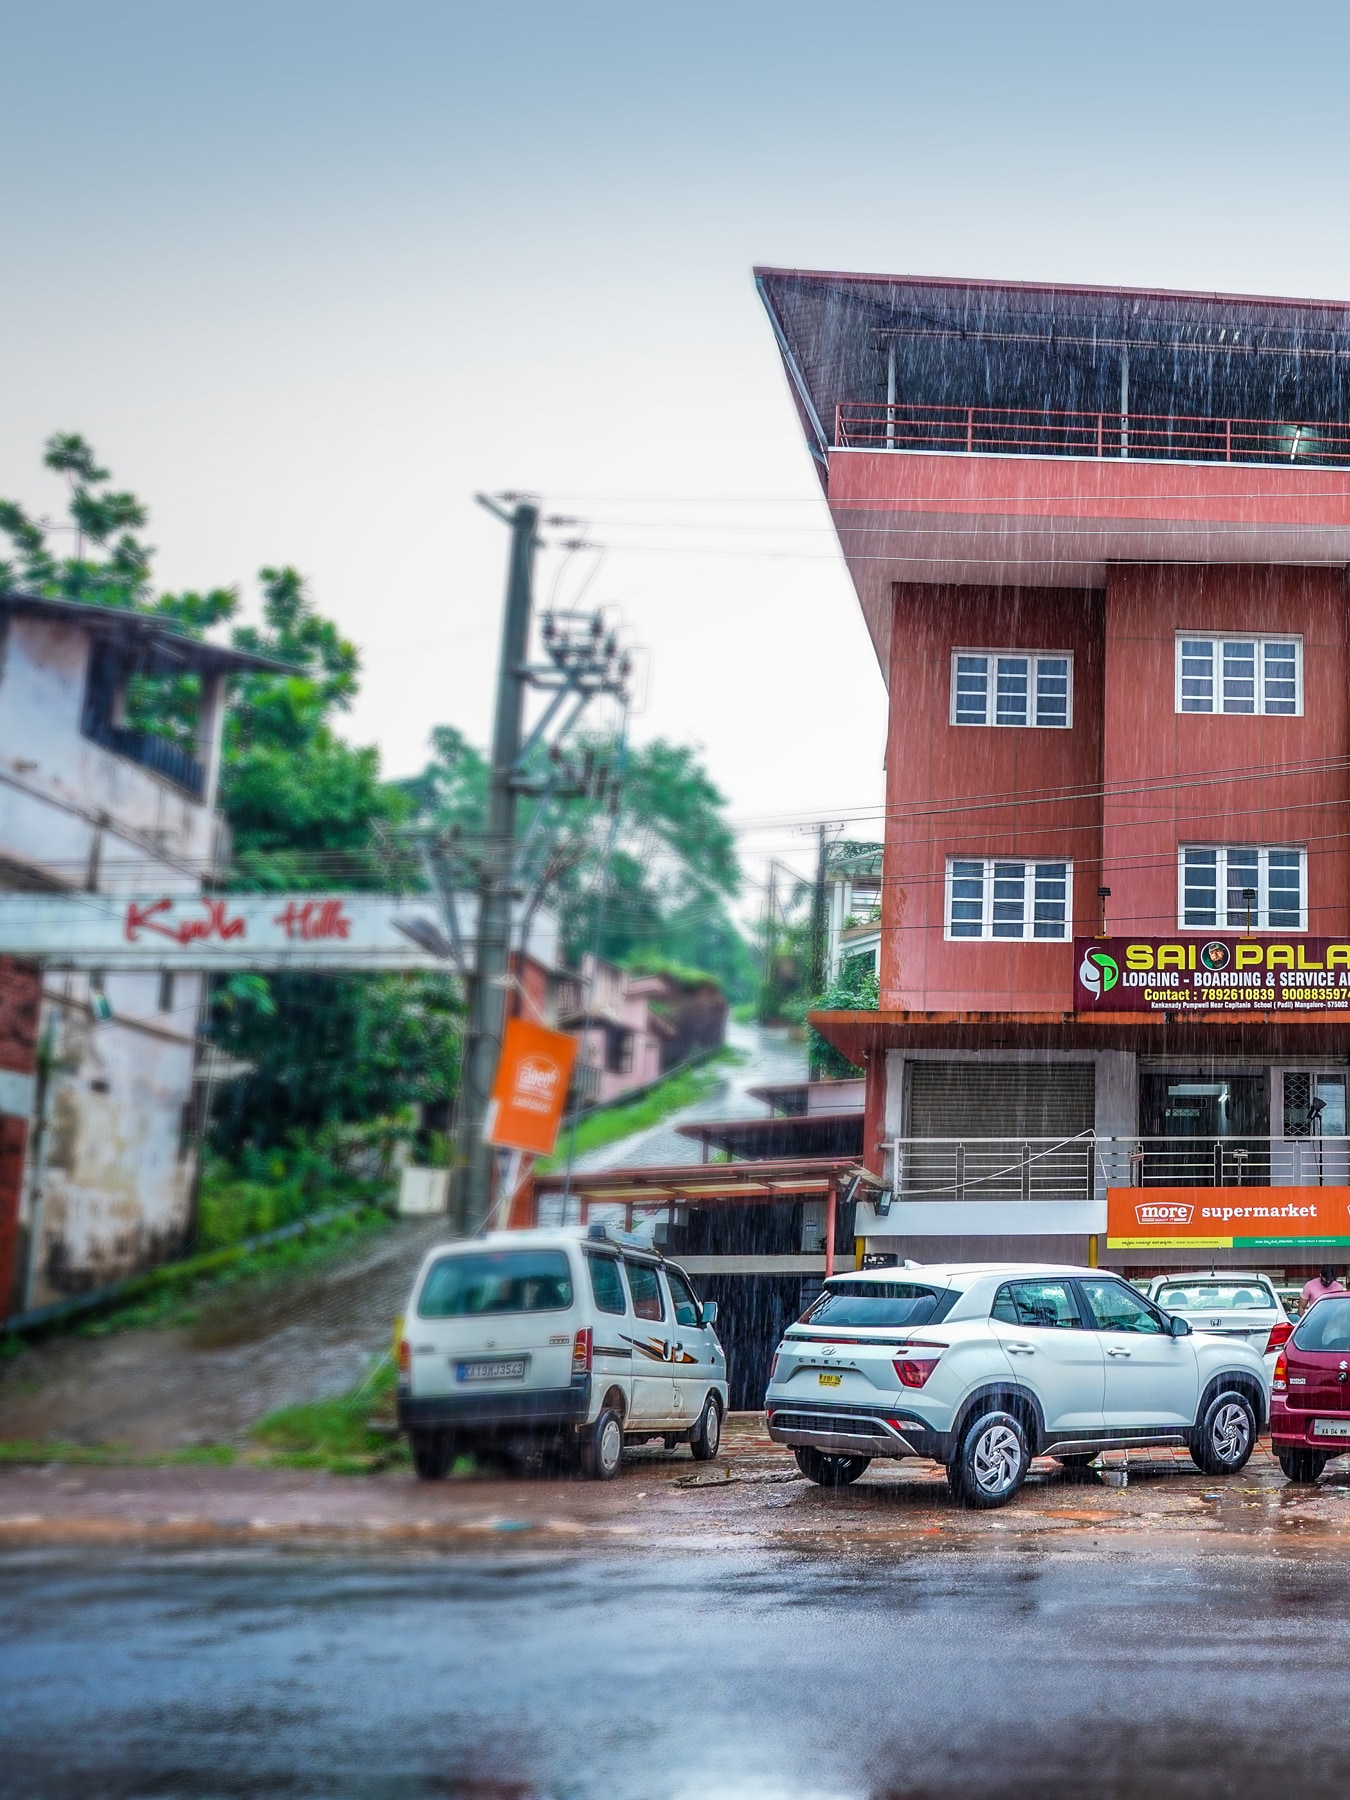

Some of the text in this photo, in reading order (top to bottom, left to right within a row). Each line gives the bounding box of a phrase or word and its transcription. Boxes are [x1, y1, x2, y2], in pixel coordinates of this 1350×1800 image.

[273, 900, 351, 941] Hills
[1125, 944, 1197, 970] SAI
[1122, 972, 1180, 987] LODGING
[1193, 972, 1261, 987] BOARDING
[1265, 972, 1276, 986] &
[1279, 971, 1335, 986] SERVICE
[1144, 989, 1190, 1001] Contact
[1201, 989, 1275, 1001] 7892610839
[1210, 1001, 1224, 1009] Near
[1141, 1203, 1318, 1221] more supermarket
[798, 1357, 856, 1366] CRETA
